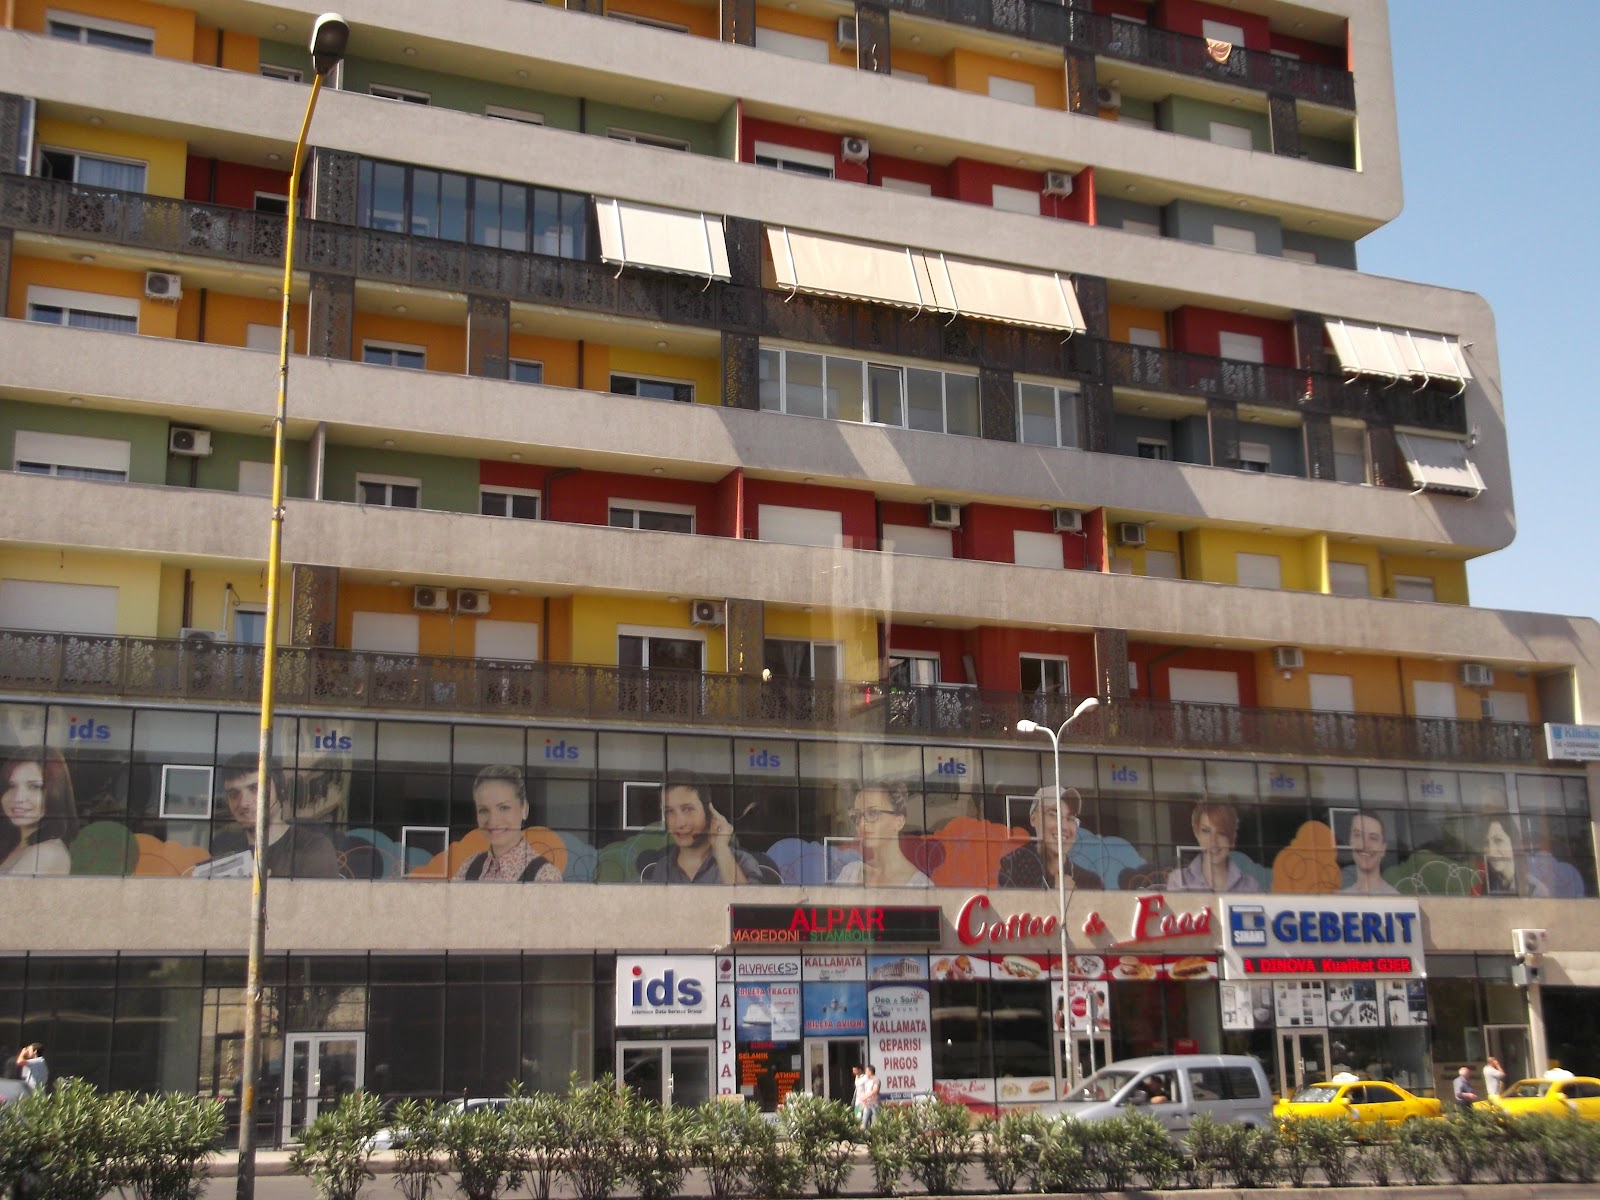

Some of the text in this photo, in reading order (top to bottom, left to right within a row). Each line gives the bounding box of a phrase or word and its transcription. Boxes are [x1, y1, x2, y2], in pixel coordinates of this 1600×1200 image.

[69, 716, 112, 740] ids
[314, 727, 352, 749] ids
[545, 738, 579, 759] ids
[750, 747, 781, 767] ids
[937, 756, 967, 775] ids
[1111, 764, 1138, 782] ids
[1269, 771, 1295, 789] ids
[1420, 779, 1444, 795] ids
[789, 907, 885, 932] ALPAR
[956, 894, 1213, 946] Coffee & Food
[1272, 910, 1416, 943] GEBERIT
[732, 929, 800, 942] MAQEDONI
[804, 956, 862, 967] KALLAMATA
[632, 965, 703, 1007] ids
[739, 987, 799, 996] BILETA TRAGETI
[806, 1019, 865, 1029] BILETA AVIONI
[872, 1019, 928, 1034] KALLAMATA
[879, 1038, 922, 1052] QEPARISI
[883, 1057, 918, 1070] PIRGOS
[886, 1075, 917, 1089] PATRA
